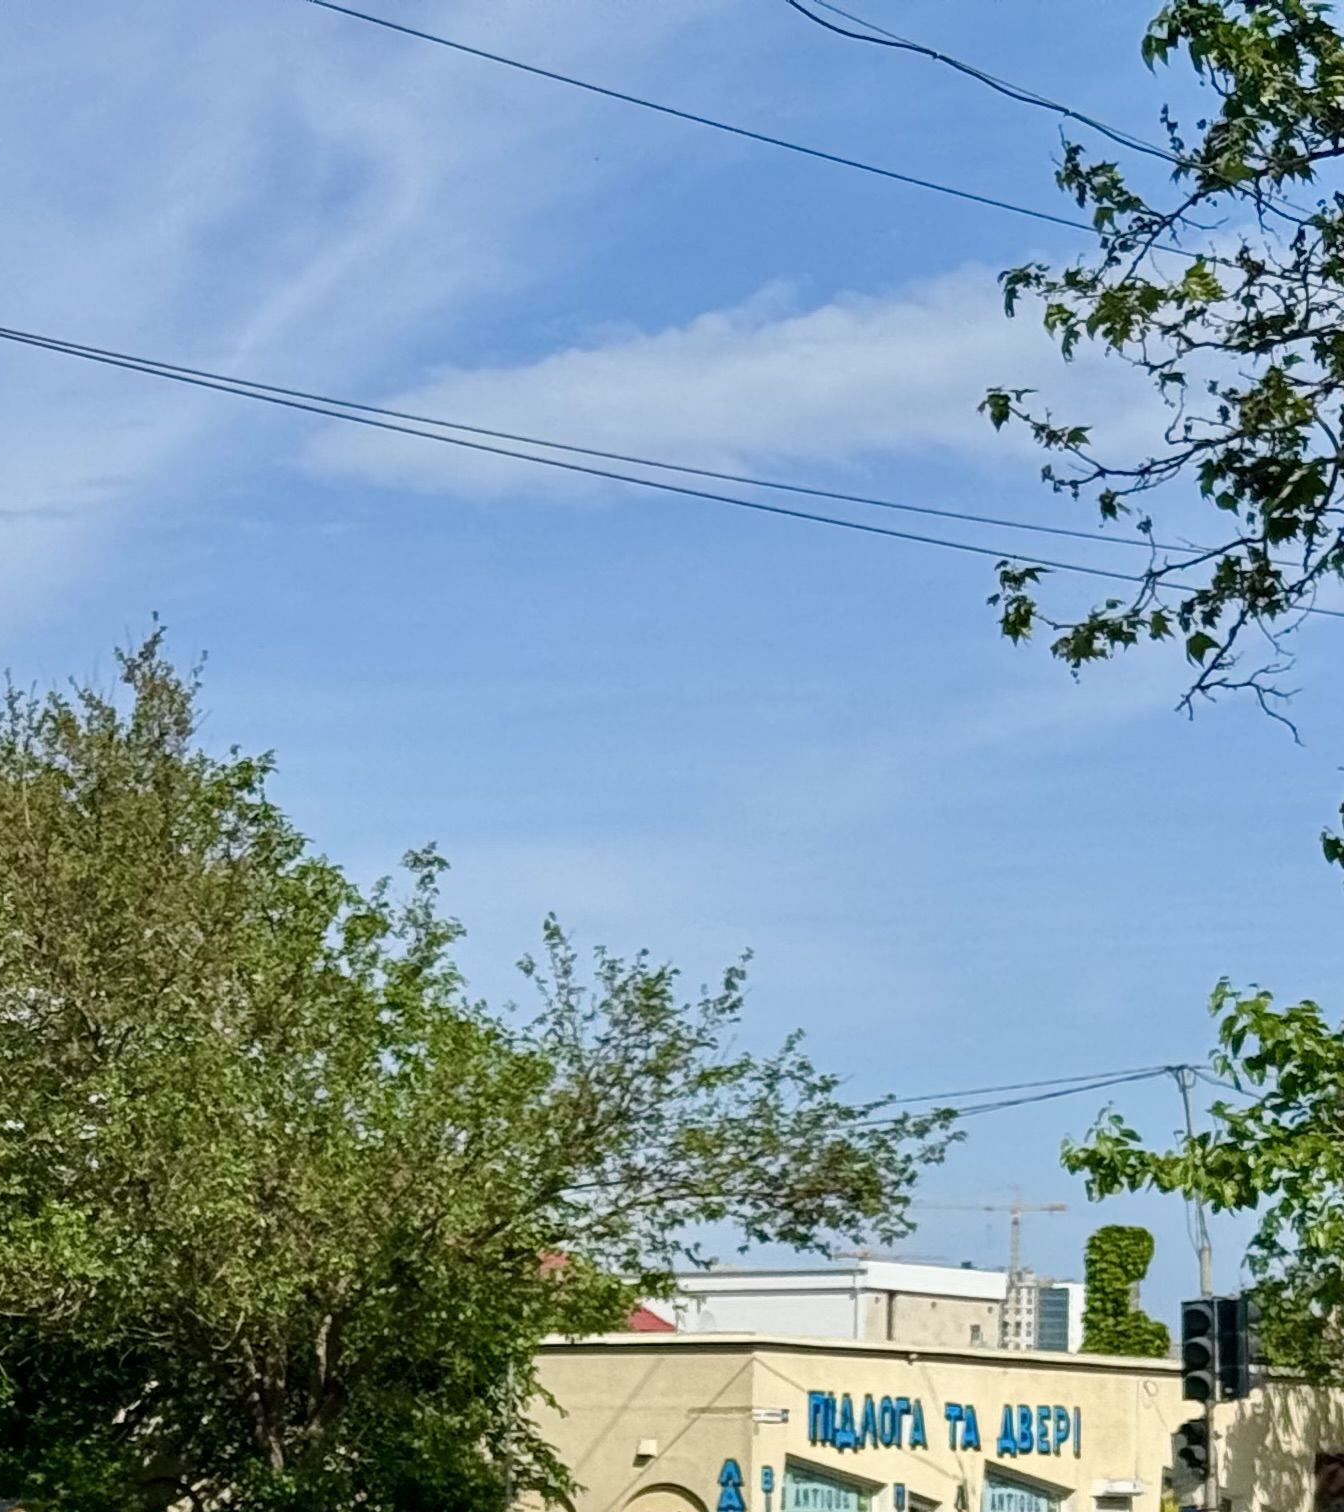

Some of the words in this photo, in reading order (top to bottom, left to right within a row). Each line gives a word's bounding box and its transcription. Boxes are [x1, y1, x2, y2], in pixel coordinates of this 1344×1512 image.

[807, 1390, 929, 1455] ПІДЛОГА
[944, 1401, 982, 1452] ТА
[996, 1403, 1082, 1460] ДВЕРІ
